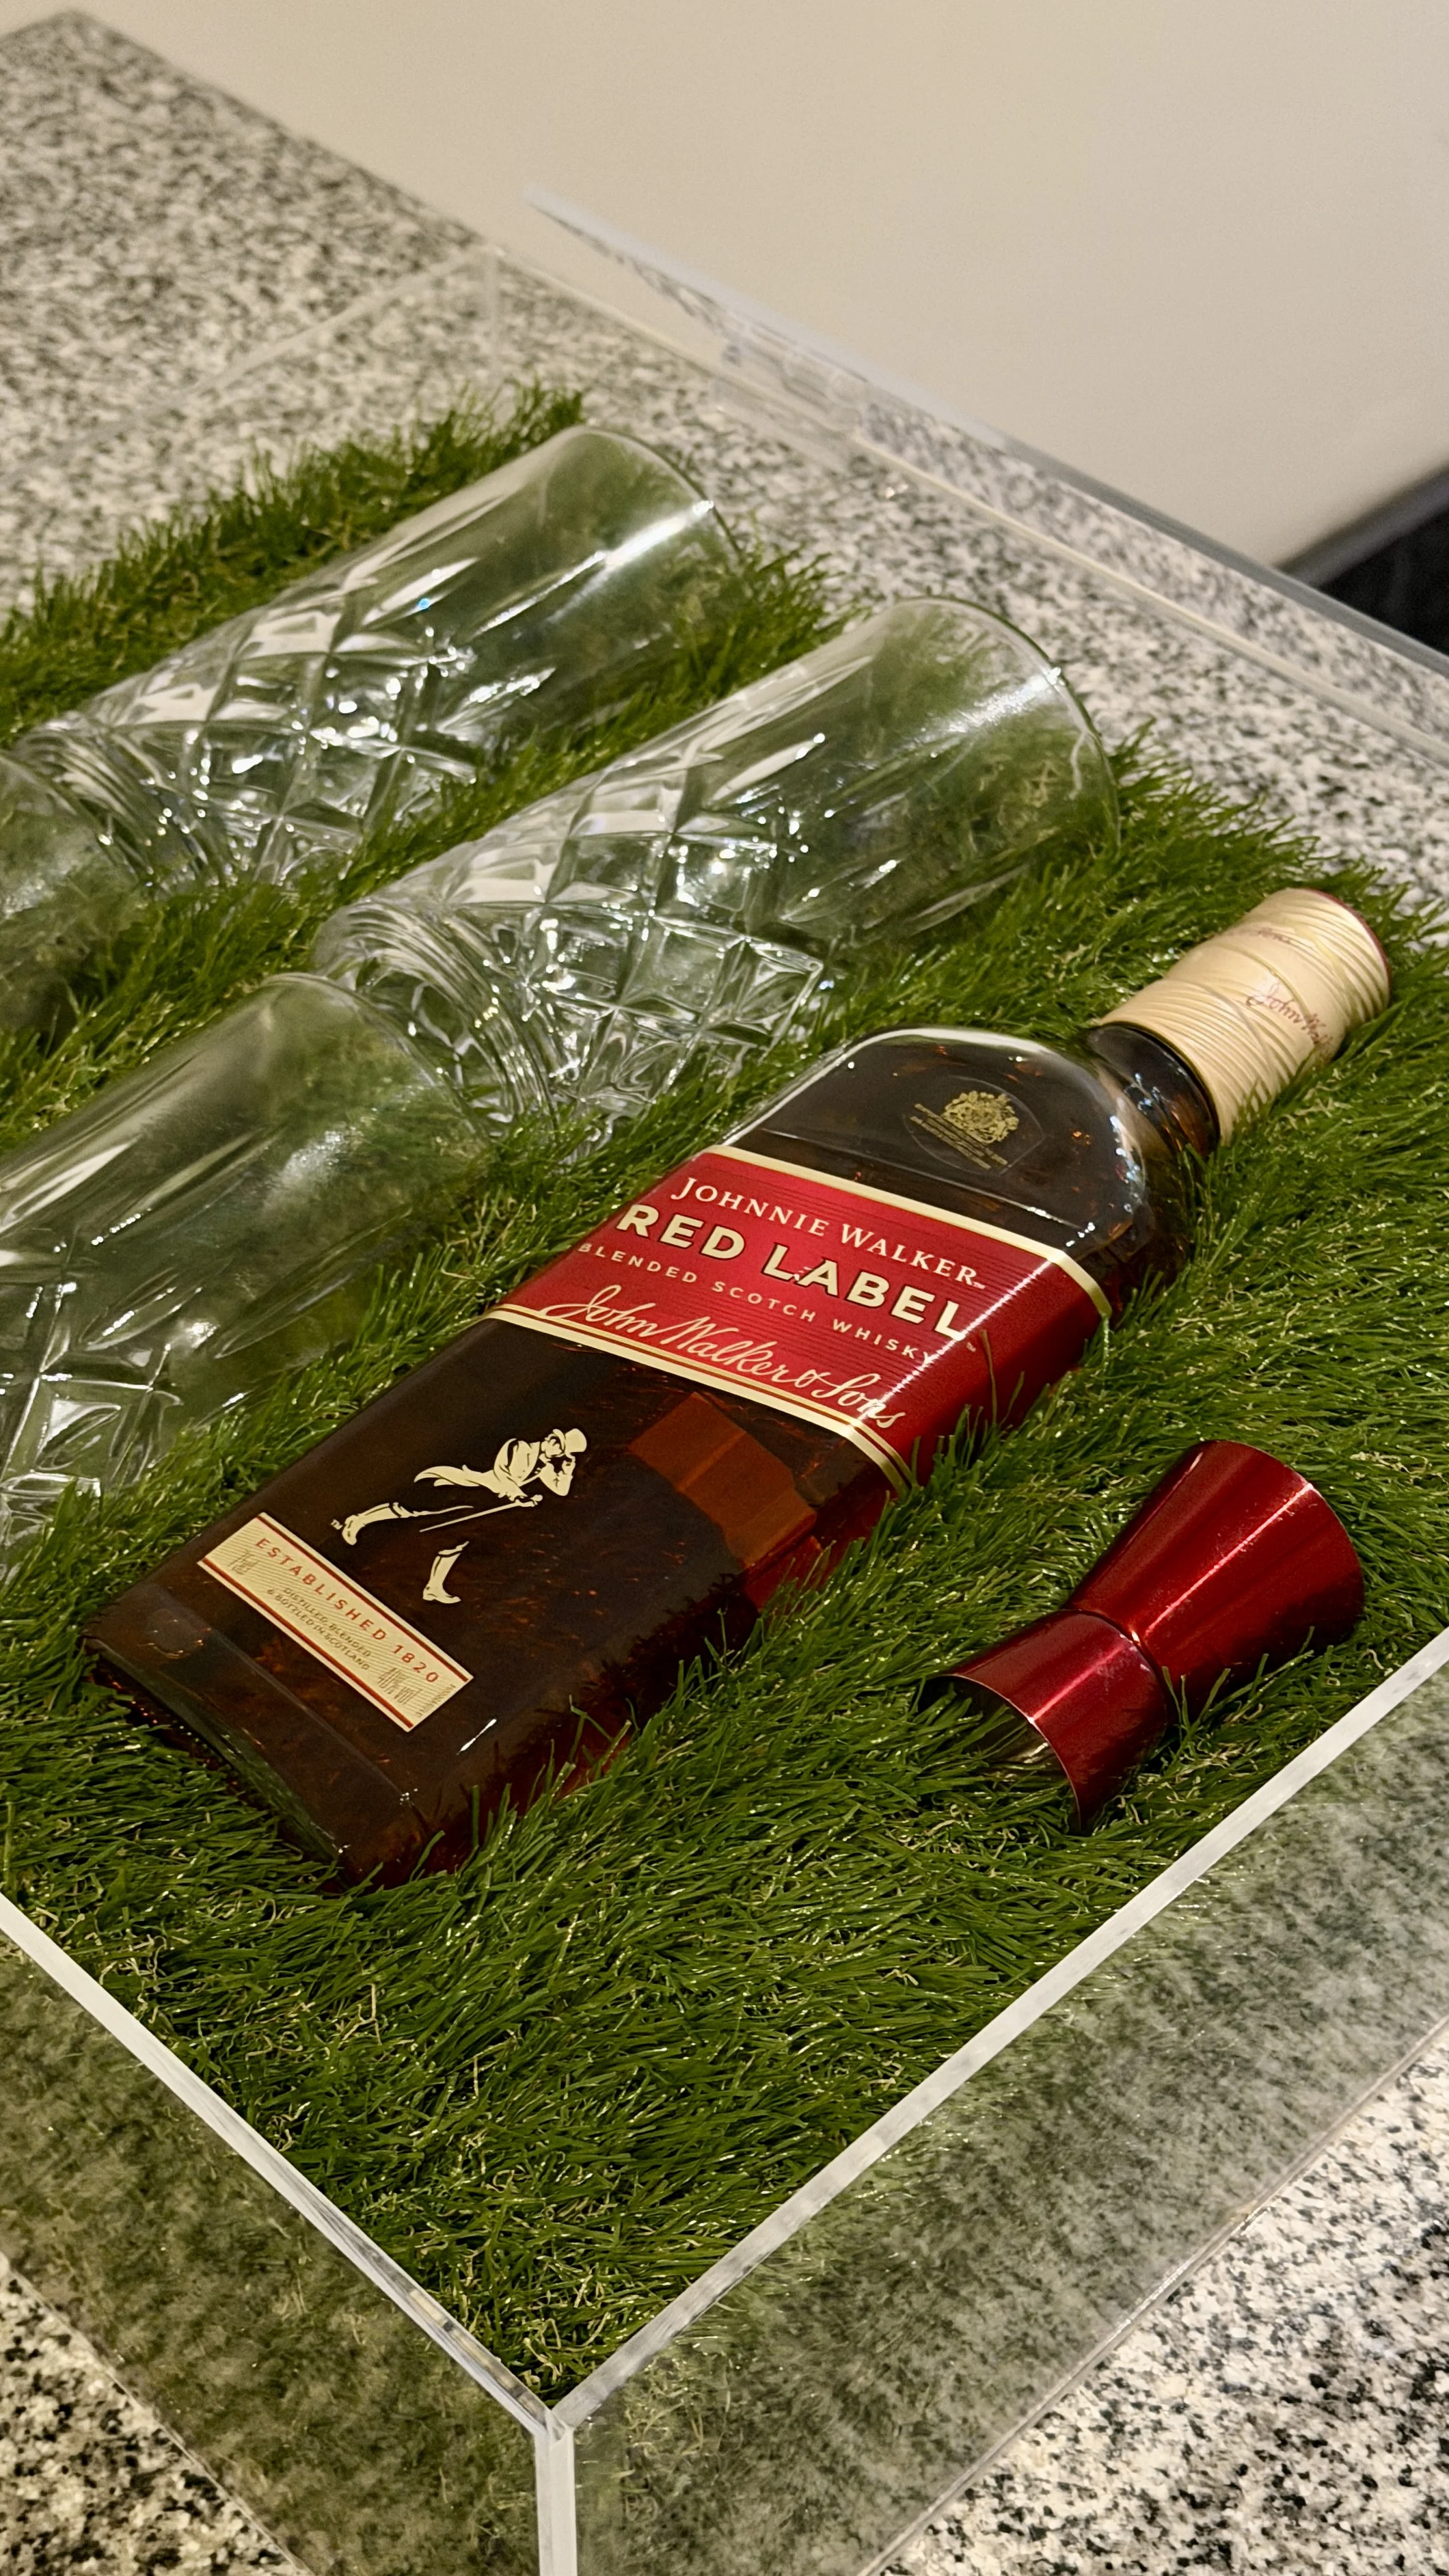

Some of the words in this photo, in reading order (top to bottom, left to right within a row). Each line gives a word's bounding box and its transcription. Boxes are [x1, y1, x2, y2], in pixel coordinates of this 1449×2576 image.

[617, 1203, 746, 1261] RED
[762, 1243, 966, 1342] LABEL
[671, 1177, 830, 1237] JOHNNIE
[841, 1224, 977, 1286] WALKER
[538, 1284, 658, 1338] John
[659, 1316, 789, 1383] Walker
[811, 1373, 906, 1429] Sons
[578, 1243, 697, 1283] BLENDED
[712, 1280, 817, 1322] SCOTCH
[832, 1318, 935, 1365] WHISKY
[256, 1538, 386, 1641] ESTABLISHED
[393, 1645, 439, 1682] 1820
[275, 1594, 314, 1626] BOTTLED
[313, 1625, 326, 1635] IN
[325, 1634, 371, 1670] SCOTLAND
[328, 1622, 372, 1657] BLENDED
